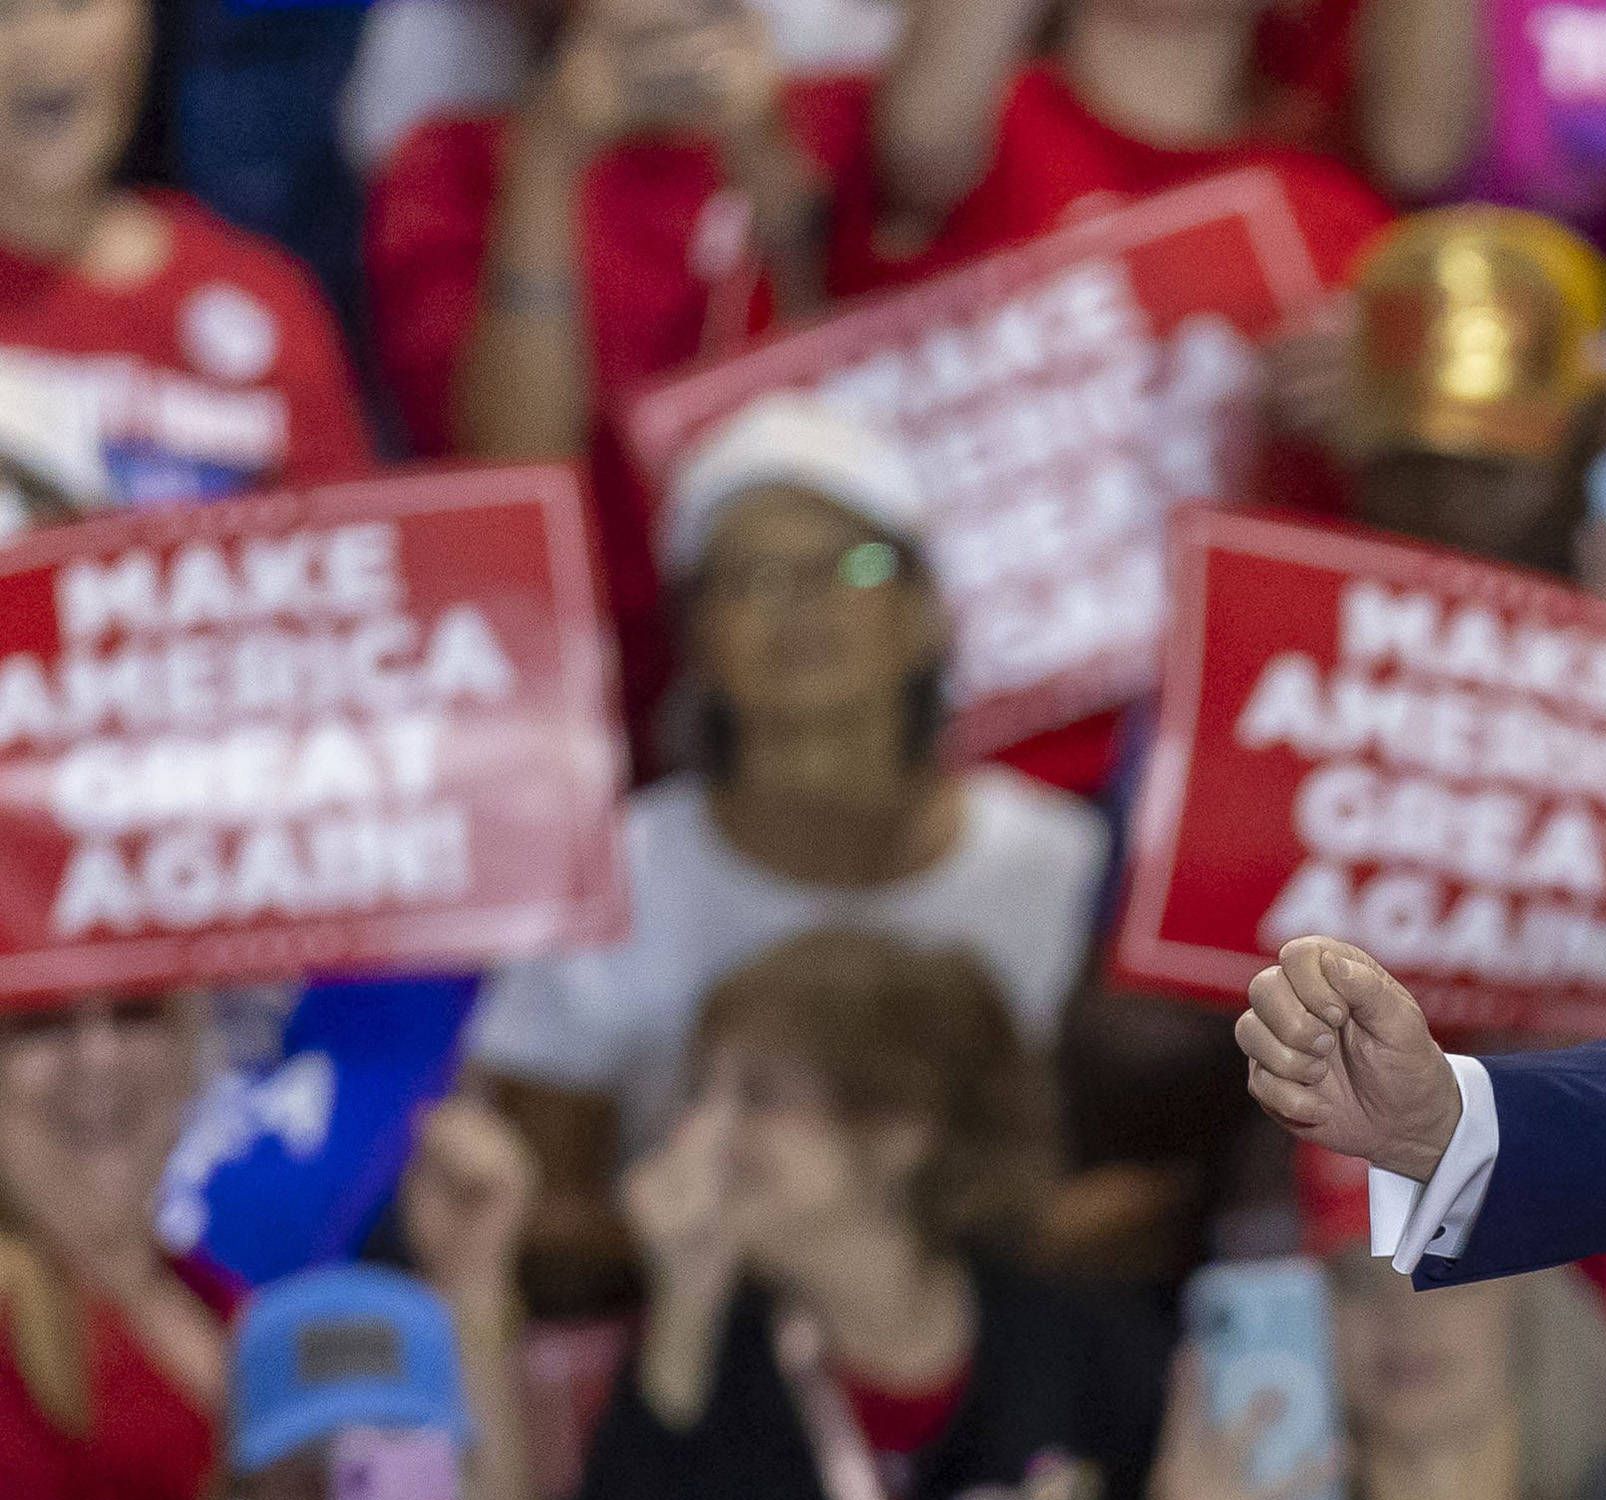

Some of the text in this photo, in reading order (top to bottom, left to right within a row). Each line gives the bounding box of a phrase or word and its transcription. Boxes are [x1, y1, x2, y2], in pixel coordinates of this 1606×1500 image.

[60, 518, 398, 642] MAKE
[0, 605, 512, 738] AMERICA
[57, 705, 441, 830] GREAT
[56, 805, 469, 935] AGAIN!
